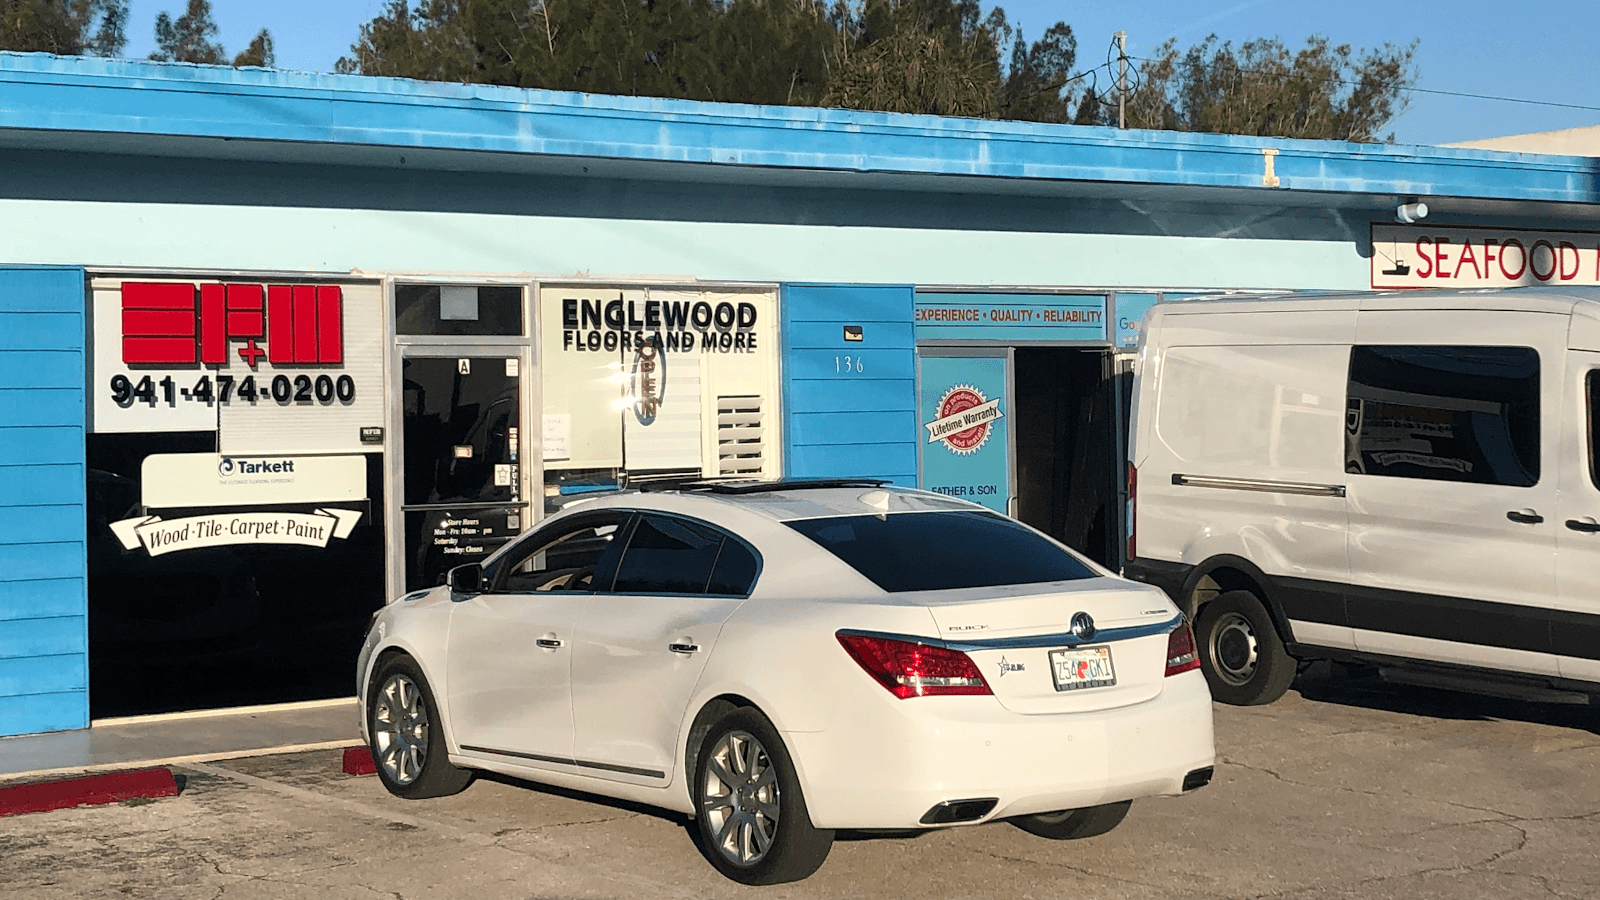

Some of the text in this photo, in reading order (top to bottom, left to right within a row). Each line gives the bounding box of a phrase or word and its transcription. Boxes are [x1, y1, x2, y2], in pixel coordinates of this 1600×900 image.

[1416, 236, 1580, 281] SEAFOOD
[562, 299, 758, 328] ENGLEWOOD
[915, 308, 1102, 323] EXPERIENCE QUALITY RELIABILITY
[564, 331, 758, 348] FLOORS AND MORE
[461, 361, 468, 373] A
[835, 356, 864, 373] 136
[110, 374, 355, 402] 941-474-0200
[931, 406, 997, 437] Lifetime Warranty
[237, 460, 294, 473] Tarkett
[931, 485, 997, 496] FATHER & SON
[150, 518, 325, 549] Wood Tile Carpet Paint
